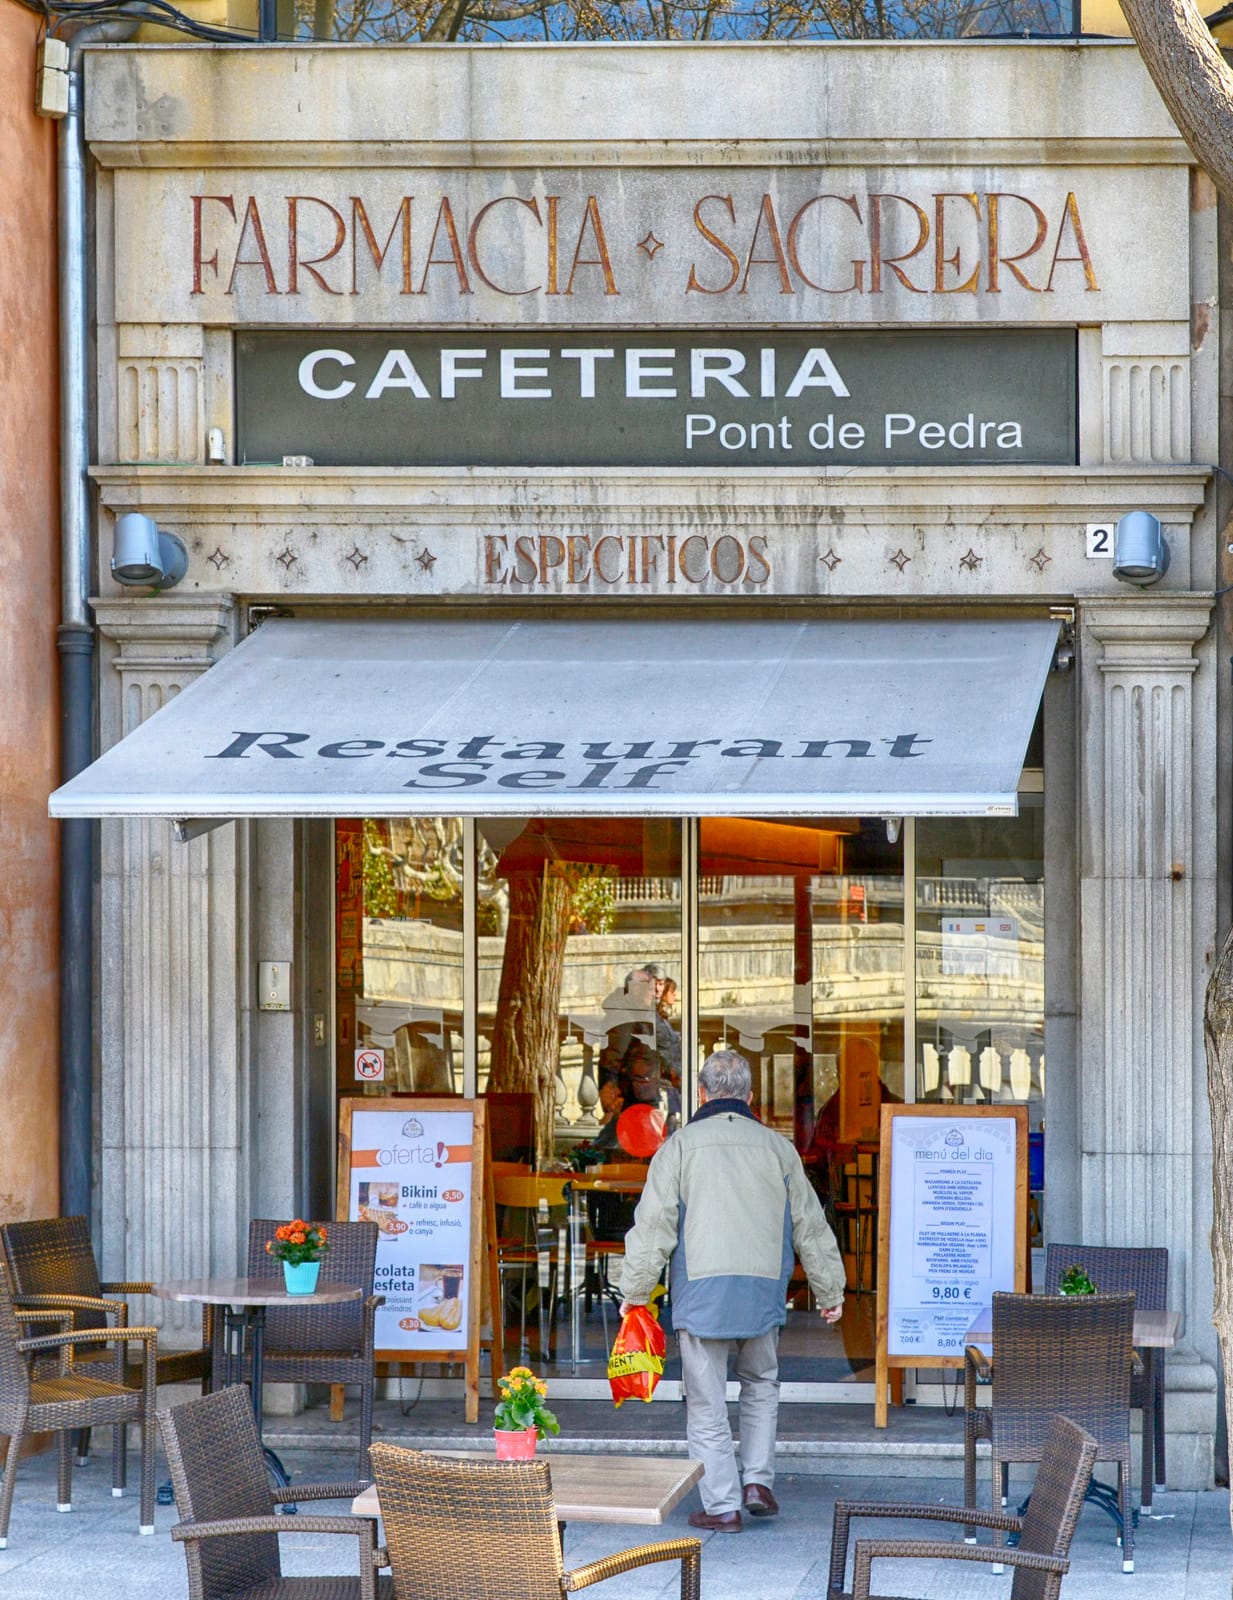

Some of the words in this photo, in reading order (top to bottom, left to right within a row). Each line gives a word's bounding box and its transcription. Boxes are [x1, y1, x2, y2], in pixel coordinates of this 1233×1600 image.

[190, 195, 620, 296] FARMACIA
[685, 191, 1100, 295] SAGRERA
[298, 348, 851, 400] CAFETERIA
[685, 414, 792, 449] Pont
[808, 414, 865, 449] de
[884, 413, 1023, 449] Pedra
[1092, 529, 1109, 553] 2
[484, 534, 771, 585] ESPECIFICOS
[204, 731, 933, 759] Restaurant
[402, 760, 690, 789] Self
[915, 1148, 946, 1160] menú
[951, 1146, 970, 1160] del
[401, 1185, 438, 1198] Bikini
[444, 1191, 462, 1200] 3,50
[429, 1202, 447, 1211] aigua
[388, 1222, 406, 1232] 3,90
[415, 1228, 433, 1237] canya
[376, 1264, 415, 1277] colata
[374, 1278, 414, 1292] esfeta
[932, 1287, 959, 1300] 9,80
[964, 1288, 972, 1299] €
[400, 1319, 419, 1330] 3,30
[938, 1339, 957, 1348] 8,80
